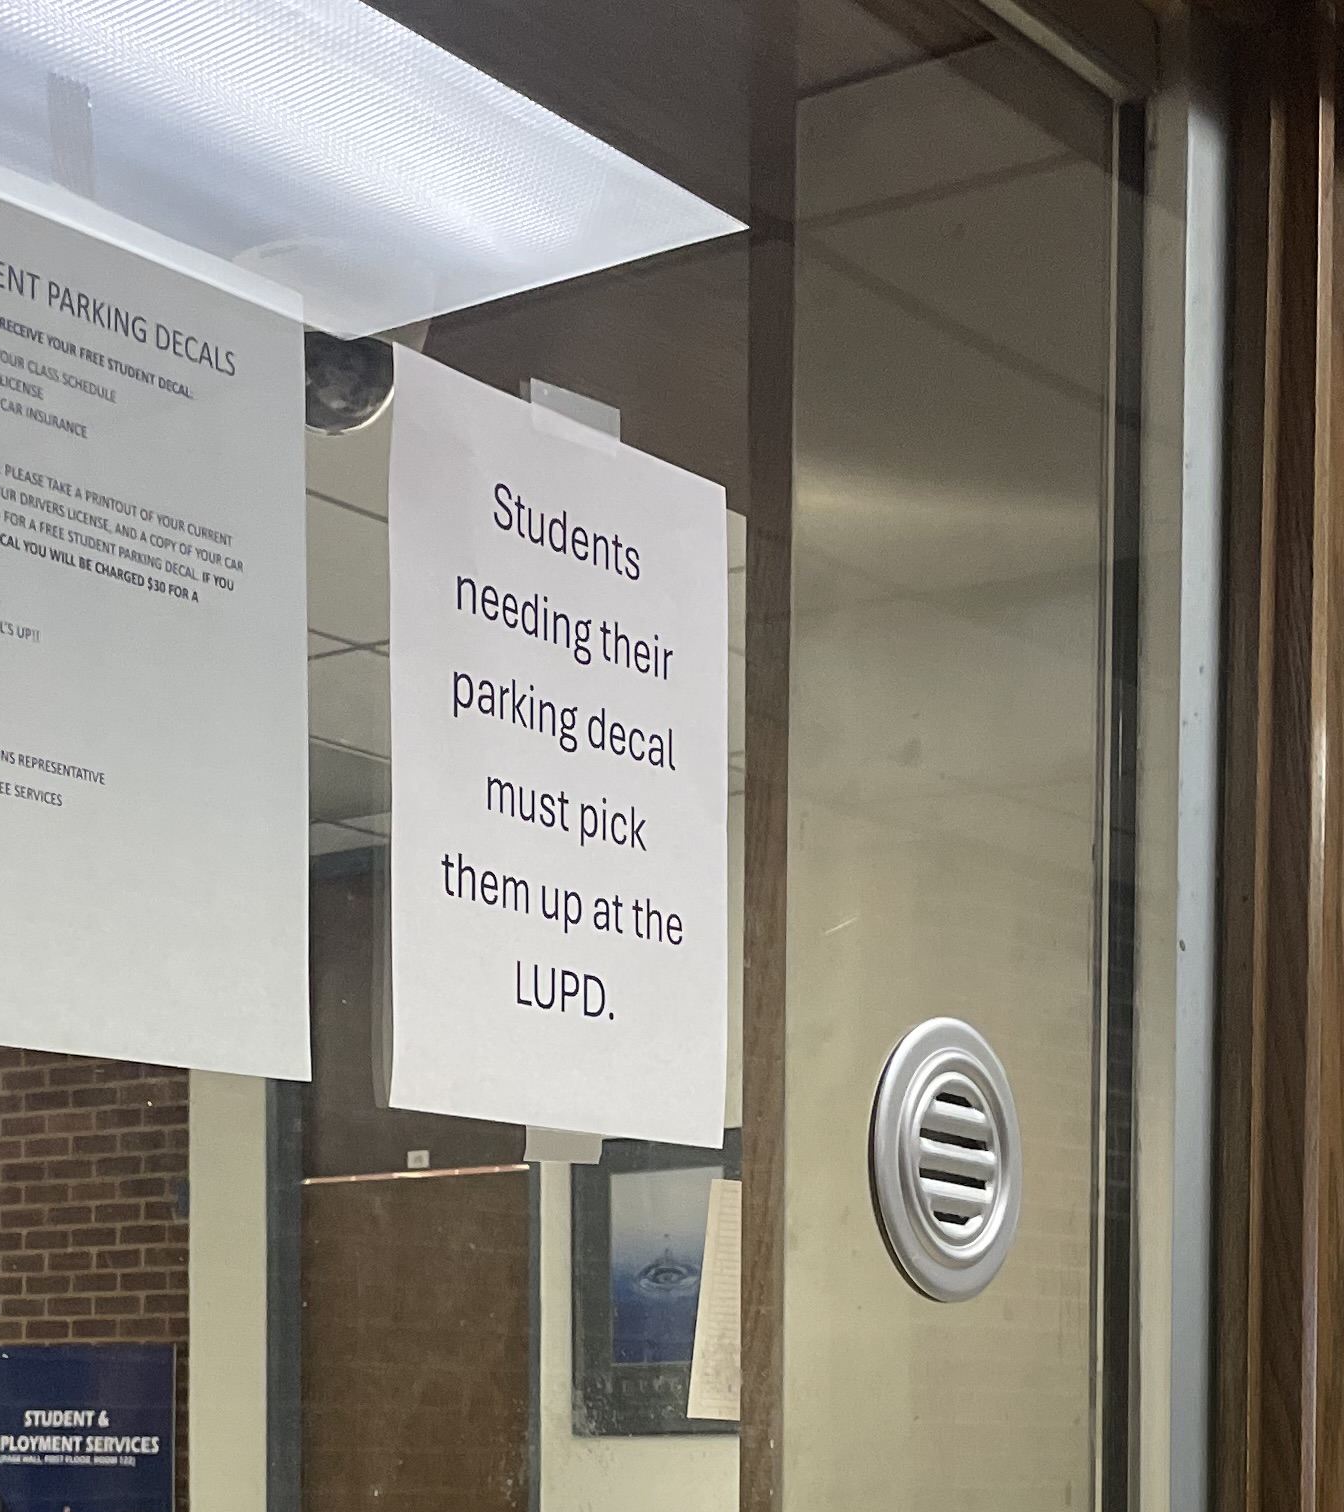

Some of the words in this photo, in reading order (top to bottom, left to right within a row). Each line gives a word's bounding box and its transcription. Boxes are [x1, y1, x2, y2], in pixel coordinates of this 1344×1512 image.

[48, 281, 146, 342] PARKING
[155, 323, 235, 375] DECALS
[26, 359, 61, 382] CLASS
[61, 371, 117, 404] SCHEDULE
[46, 333, 76, 356] YOUR
[79, 346, 104, 367] FREE
[107, 357, 155, 385] STUDENT
[0, 397, 23, 416] CAR
[25, 406, 87, 438] INSURANCE
[4, 463, 44, 487] PLEASE
[46, 476, 72, 497] TAKE
[85, 489, 138, 520] PRINTOUT
[156, 512, 185, 532] YOUR
[186, 522, 232, 546] CURRENT
[494, 484, 639, 580] Students
[22, 539, 46, 558] YOU
[48, 546, 75, 567] WILL
[94, 561, 144, 586] CHARGED
[147, 576, 165, 593] $30
[168, 583, 189, 599] FOR
[457, 576, 591, 665] needing
[600, 621, 673, 680] their
[454, 672, 577, 752] parking
[588, 708, 675, 770] decal
[14, 782, 62, 806] SERVICES
[18, 753, 105, 785] REPRESENTATIVE
[488, 777, 569, 831] must
[581, 798, 646, 851] pick
[442, 853, 528, 913] them
[542, 886, 581, 933] up
[594, 895, 623, 934] at
[633, 898, 682, 945] the
[517, 961, 613, 1020] LUPD.
[24, 1410, 95, 1427] STUDENT
[97, 1411, 109, 1428] &
[85, 1436, 160, 1454] SERVICES
